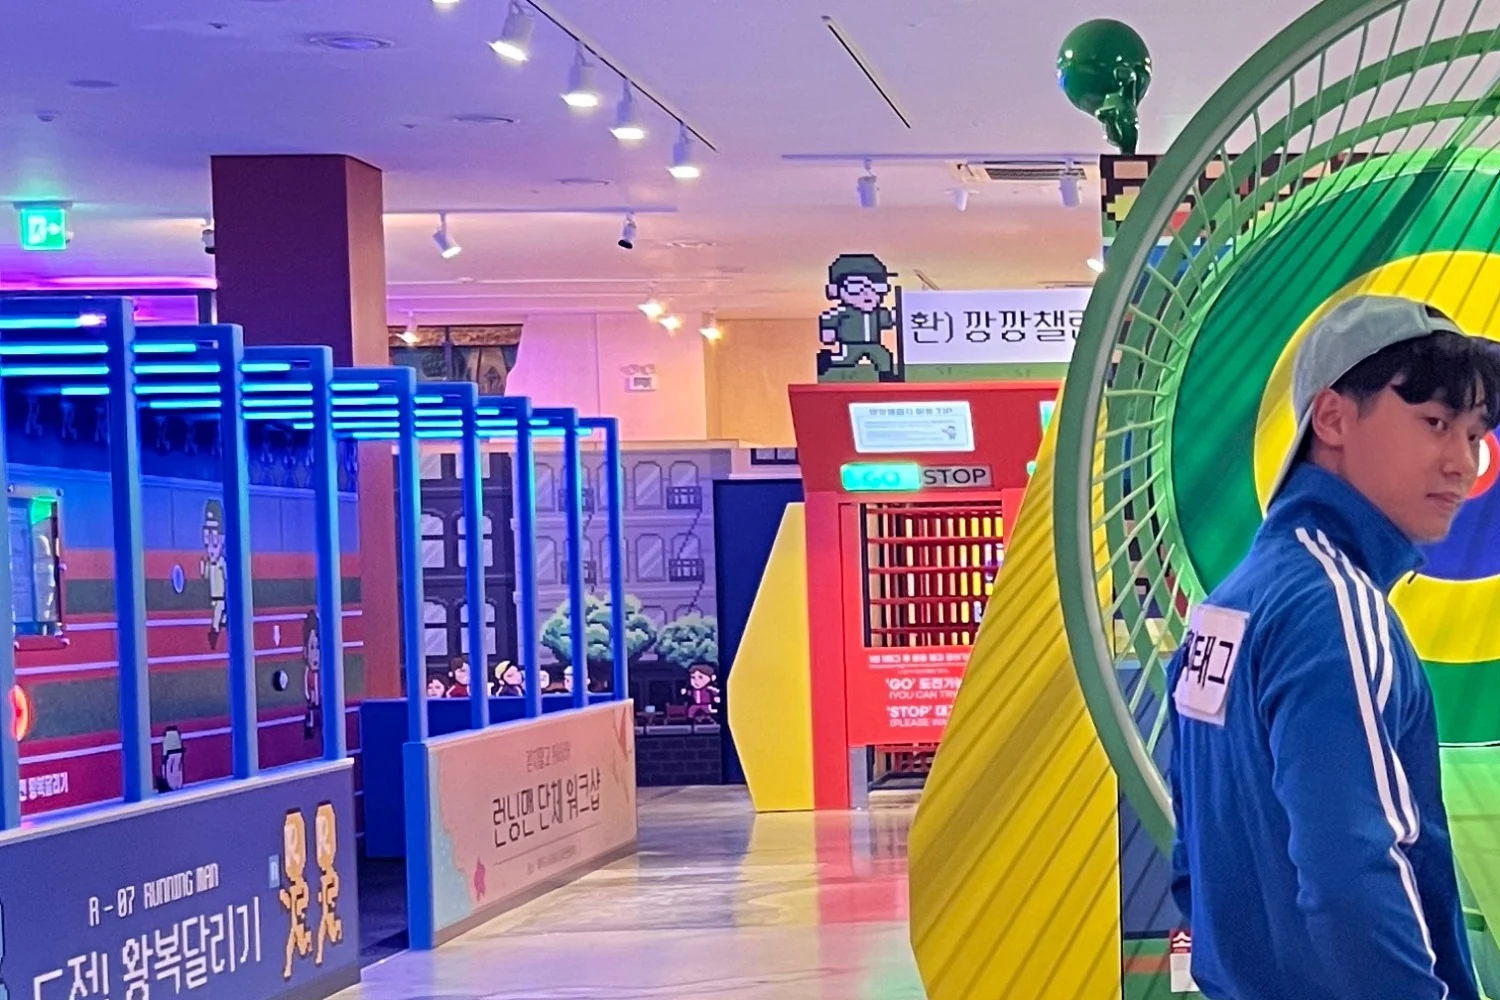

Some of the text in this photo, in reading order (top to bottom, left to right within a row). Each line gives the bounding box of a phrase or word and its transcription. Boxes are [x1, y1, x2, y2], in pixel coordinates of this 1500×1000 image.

[910, 310, 954, 344] 환)
[923, 468, 987, 485] STOP
[493, 767, 601, 848] 런닝맨 단체 워크샵
[144, 870, 194, 910] RUNNING
[196, 863, 219, 893] MAN
